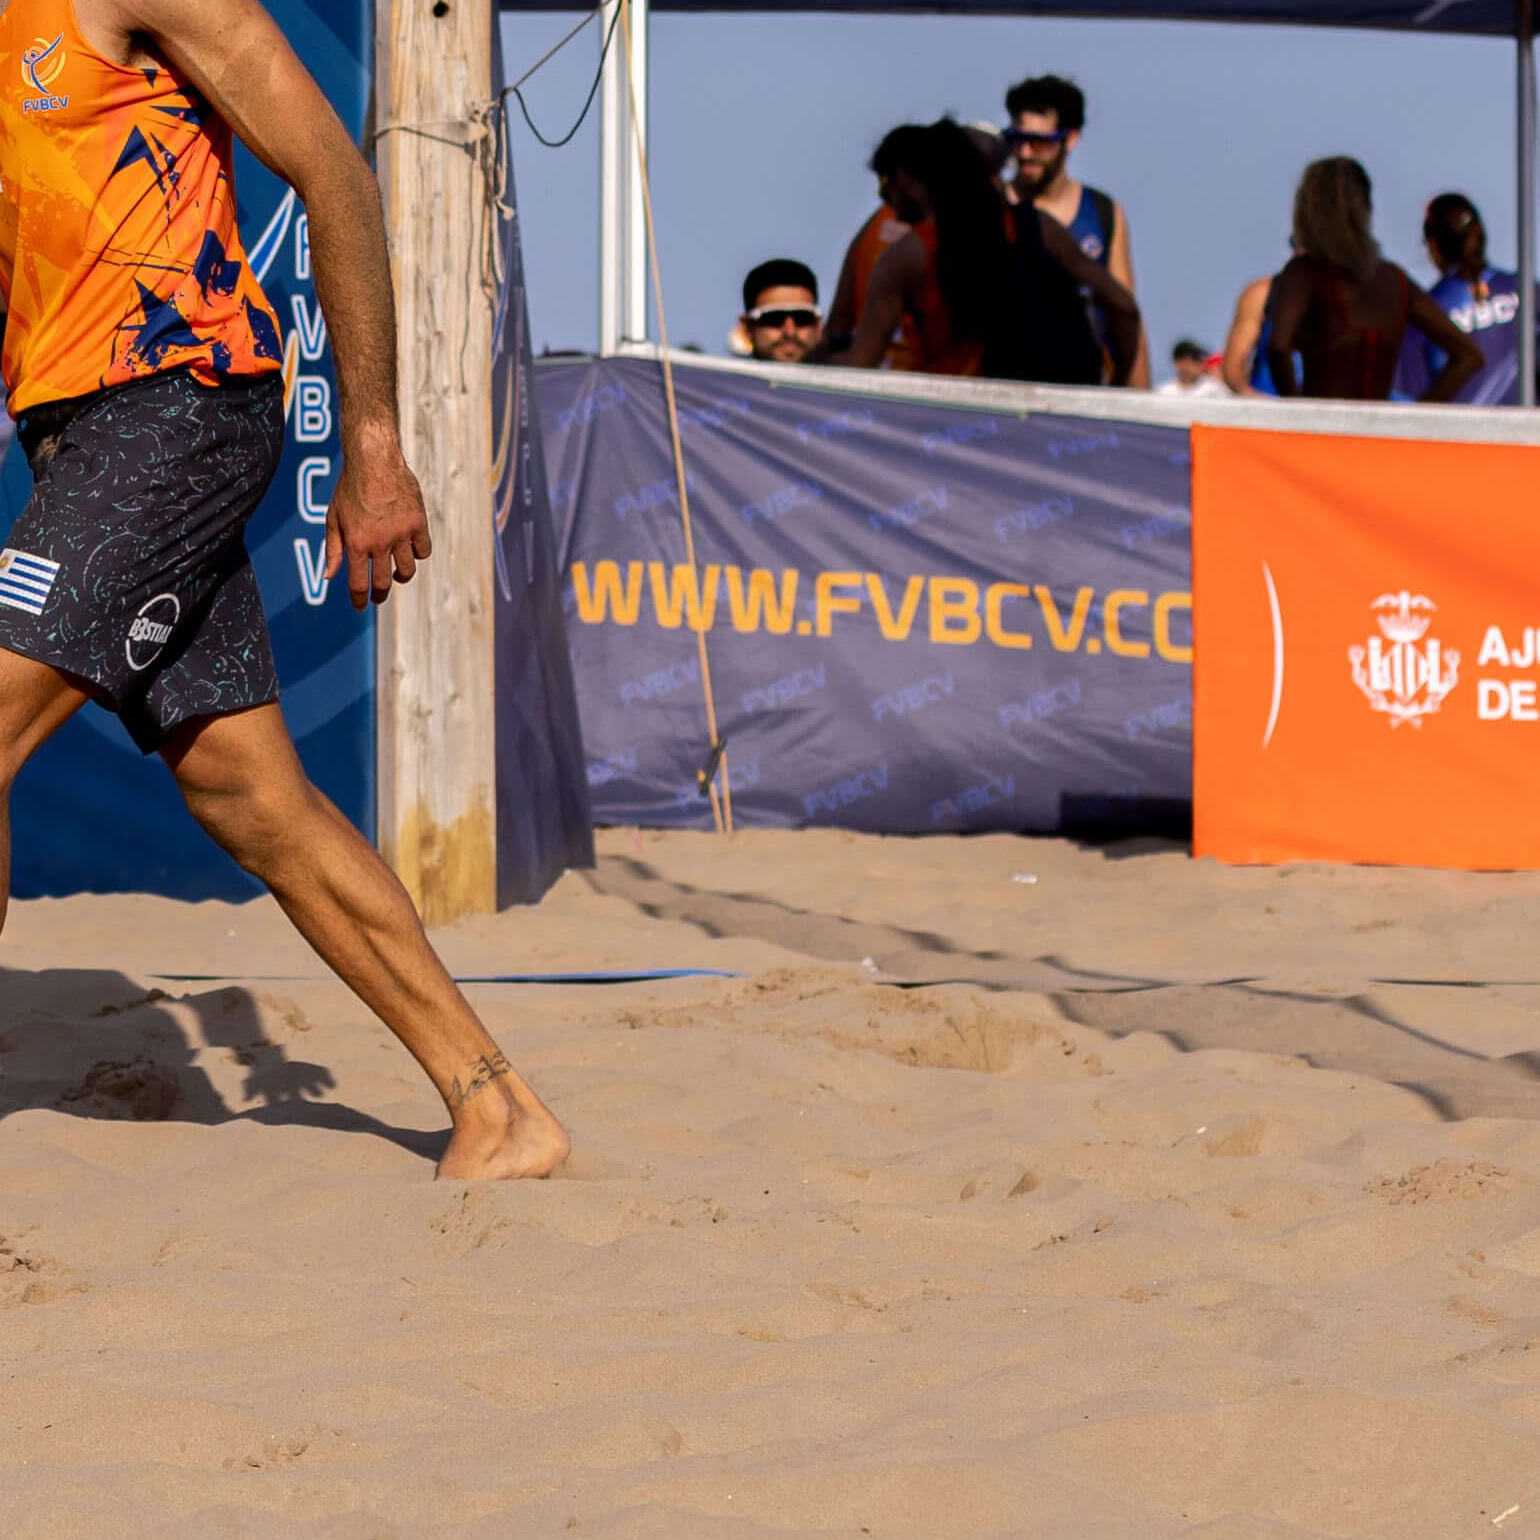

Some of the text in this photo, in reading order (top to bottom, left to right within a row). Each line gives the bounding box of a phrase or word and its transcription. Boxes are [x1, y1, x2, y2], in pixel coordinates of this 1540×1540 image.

[23, 94, 70, 114] FVBCV
[572, 560, 1191, 663] WWW.FVBCV.CO
[1477, 625, 1540, 669] AJ
[870, 672, 955, 724] FVBCV
[802, 763, 890, 818] FVBCV
